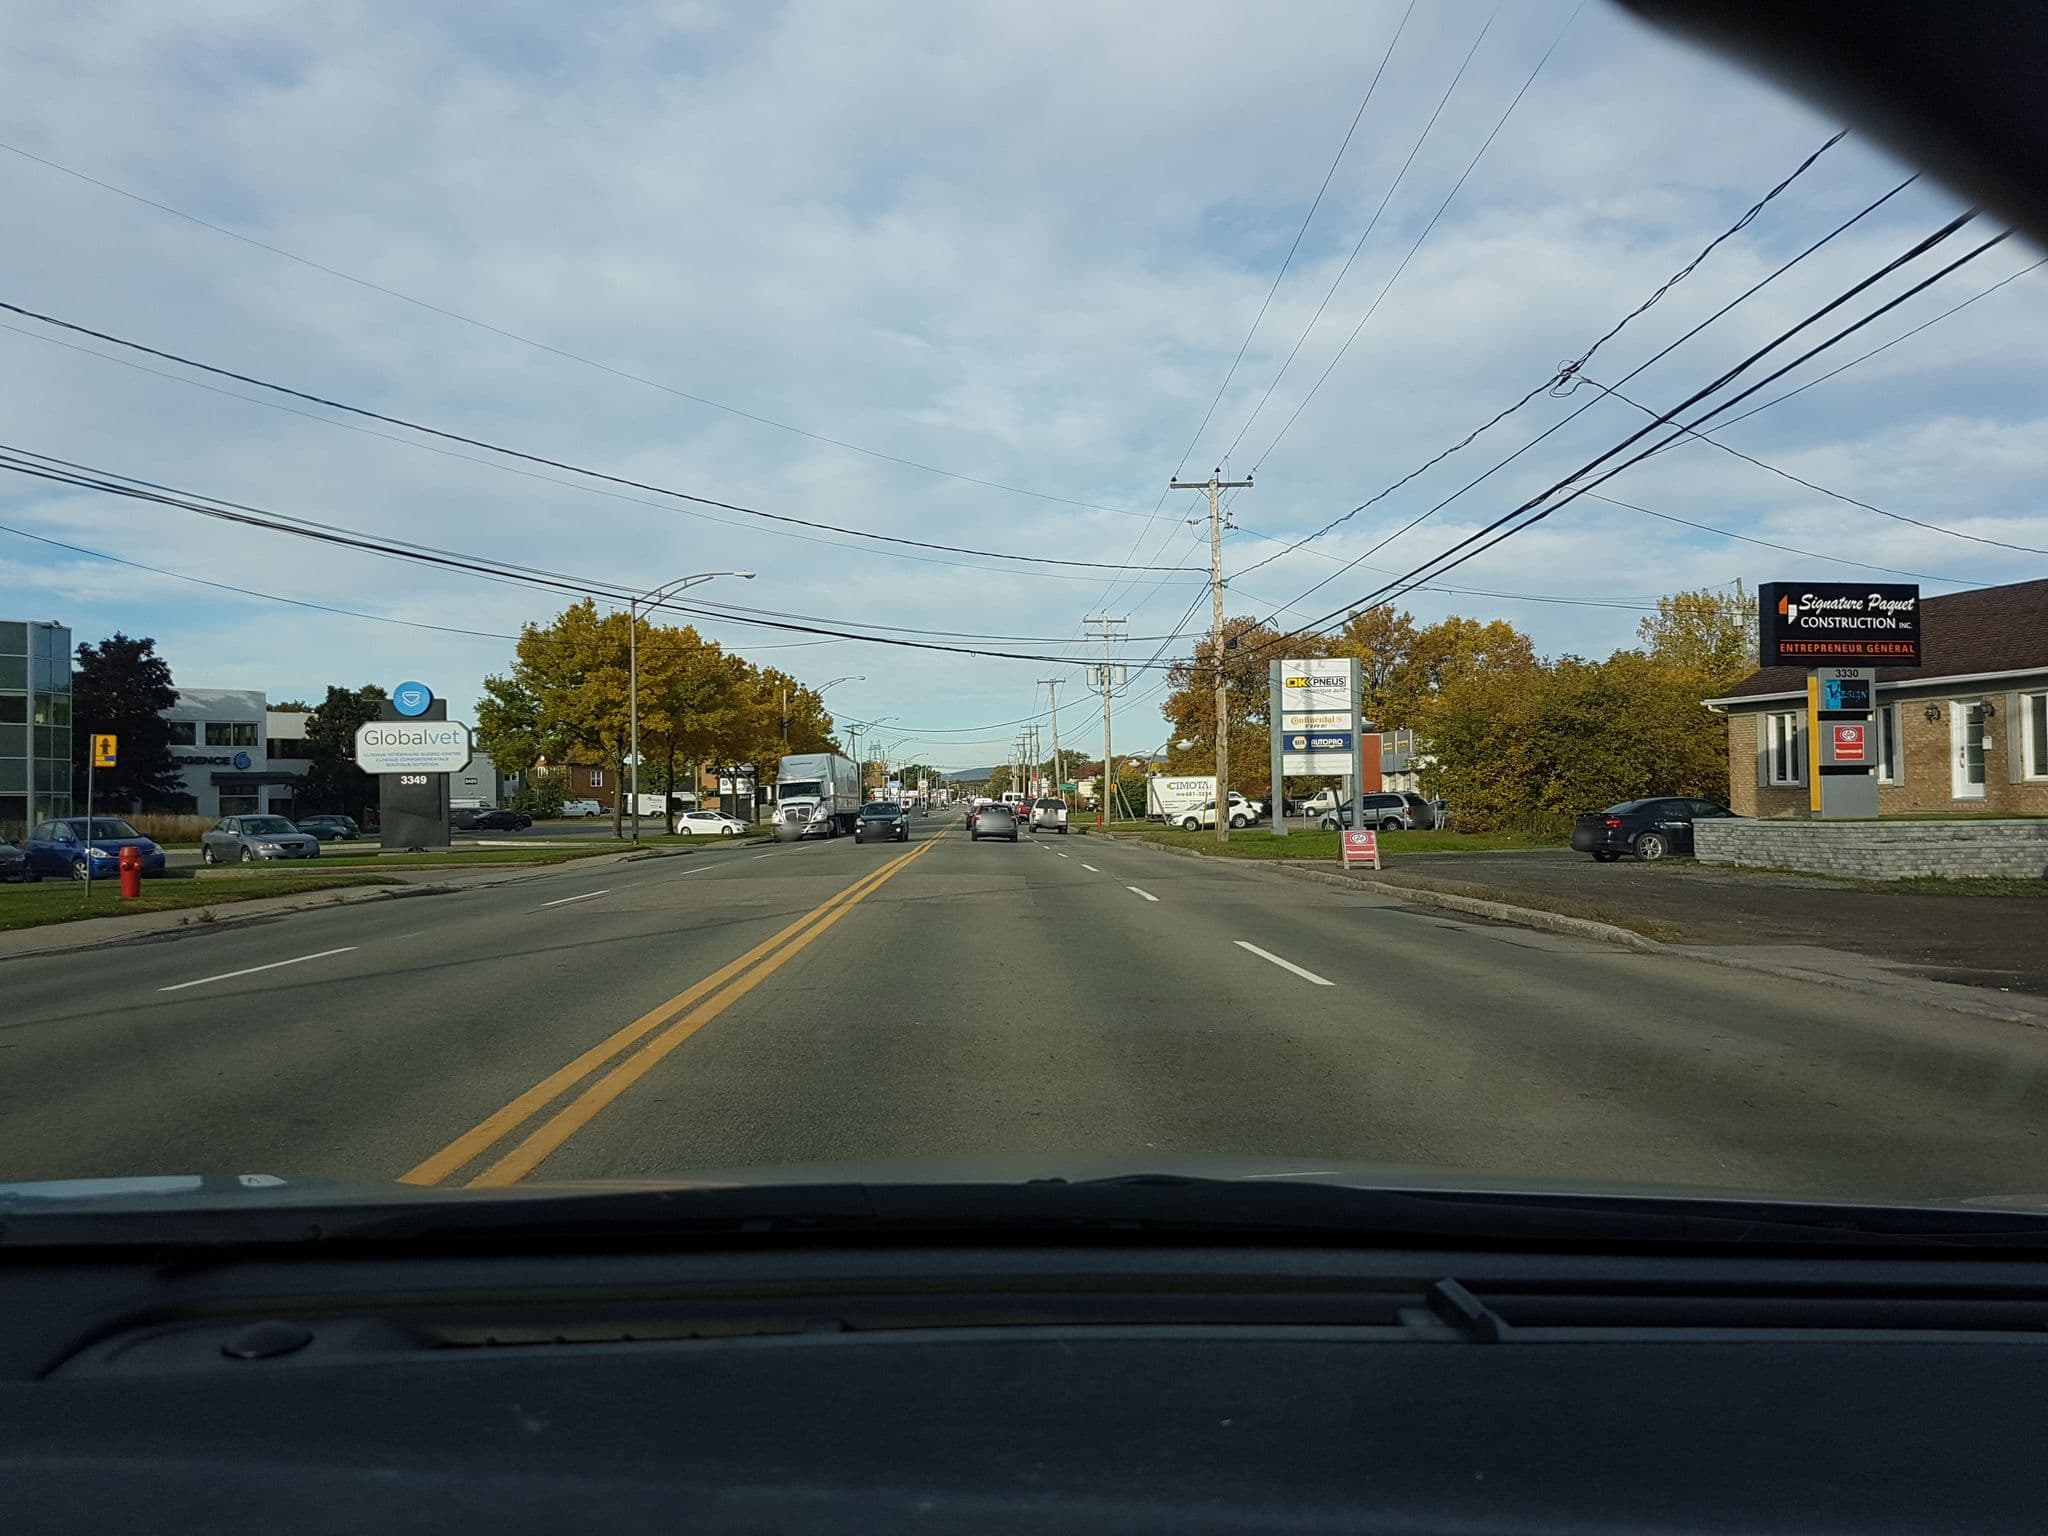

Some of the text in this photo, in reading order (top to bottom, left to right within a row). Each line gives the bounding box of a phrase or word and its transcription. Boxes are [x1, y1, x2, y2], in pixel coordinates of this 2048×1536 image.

[1799, 593, 1915, 616] Signature Paquet
[1800, 617, 1896, 629] CONSTRUCTION
[1779, 641, 1915, 653] ENTREPRENEUR GÉNÉRAL
[1835, 669, 1859, 678] 3330
[1286, 677, 1345, 688] OK PNEUS
[1291, 715, 1335, 725] Continental
[364, 729, 460, 746] Globalvet
[1311, 738, 1343, 746] AUTOPRO
[400, 775, 427, 785] 3349
